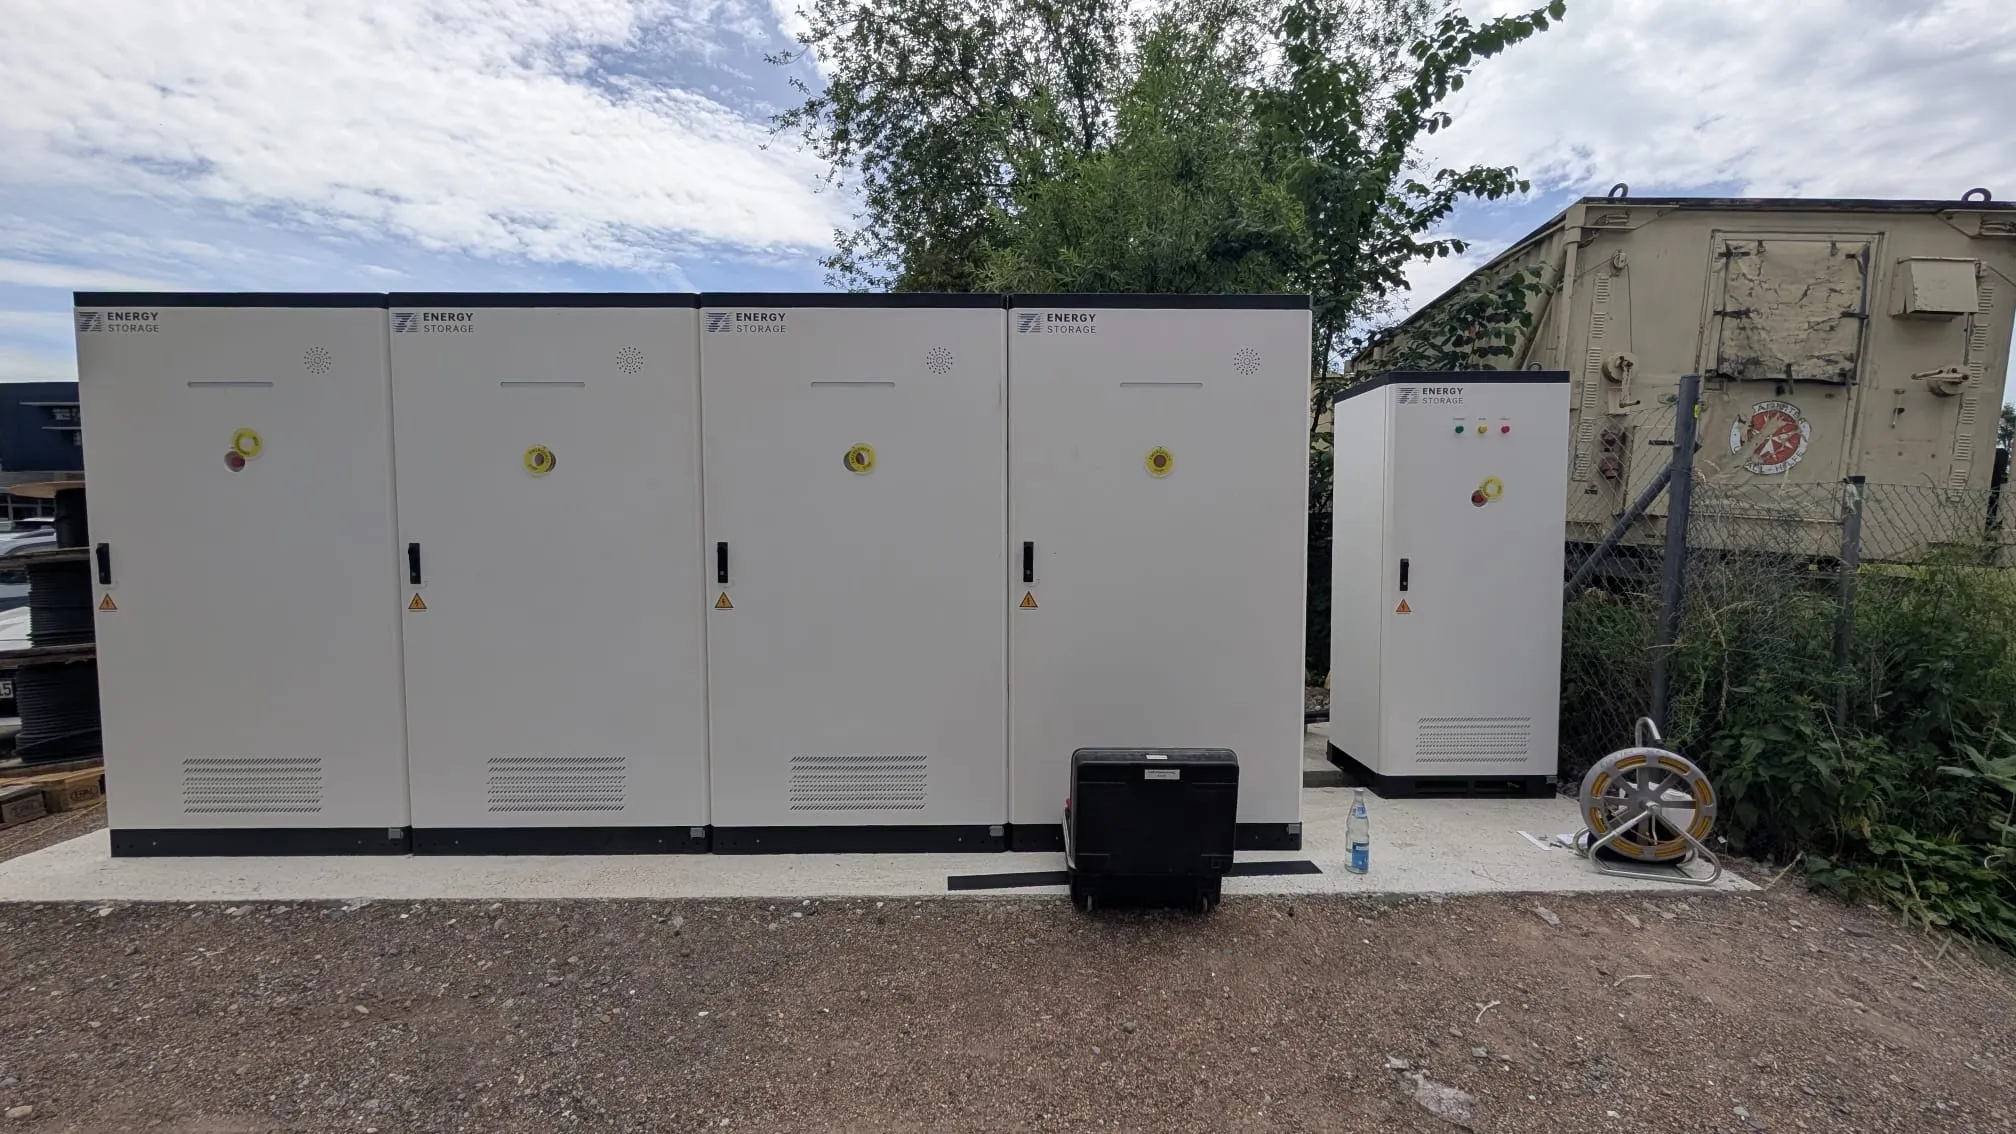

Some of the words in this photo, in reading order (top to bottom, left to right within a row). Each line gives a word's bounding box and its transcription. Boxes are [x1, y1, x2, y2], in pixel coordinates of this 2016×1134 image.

[107, 311, 158, 321] ENERGY
[423, 312, 473, 321] ENERGY
[736, 312, 785, 321] ENERGY
[1047, 313, 1096, 322] ENERGY
[108, 324, 160, 332] STORAGE
[424, 324, 474, 333] STORAGE
[736, 324, 786, 333] STORAGE
[1047, 325, 1096, 333] STORAGE
[1422, 387, 1463, 395] ENERGY
